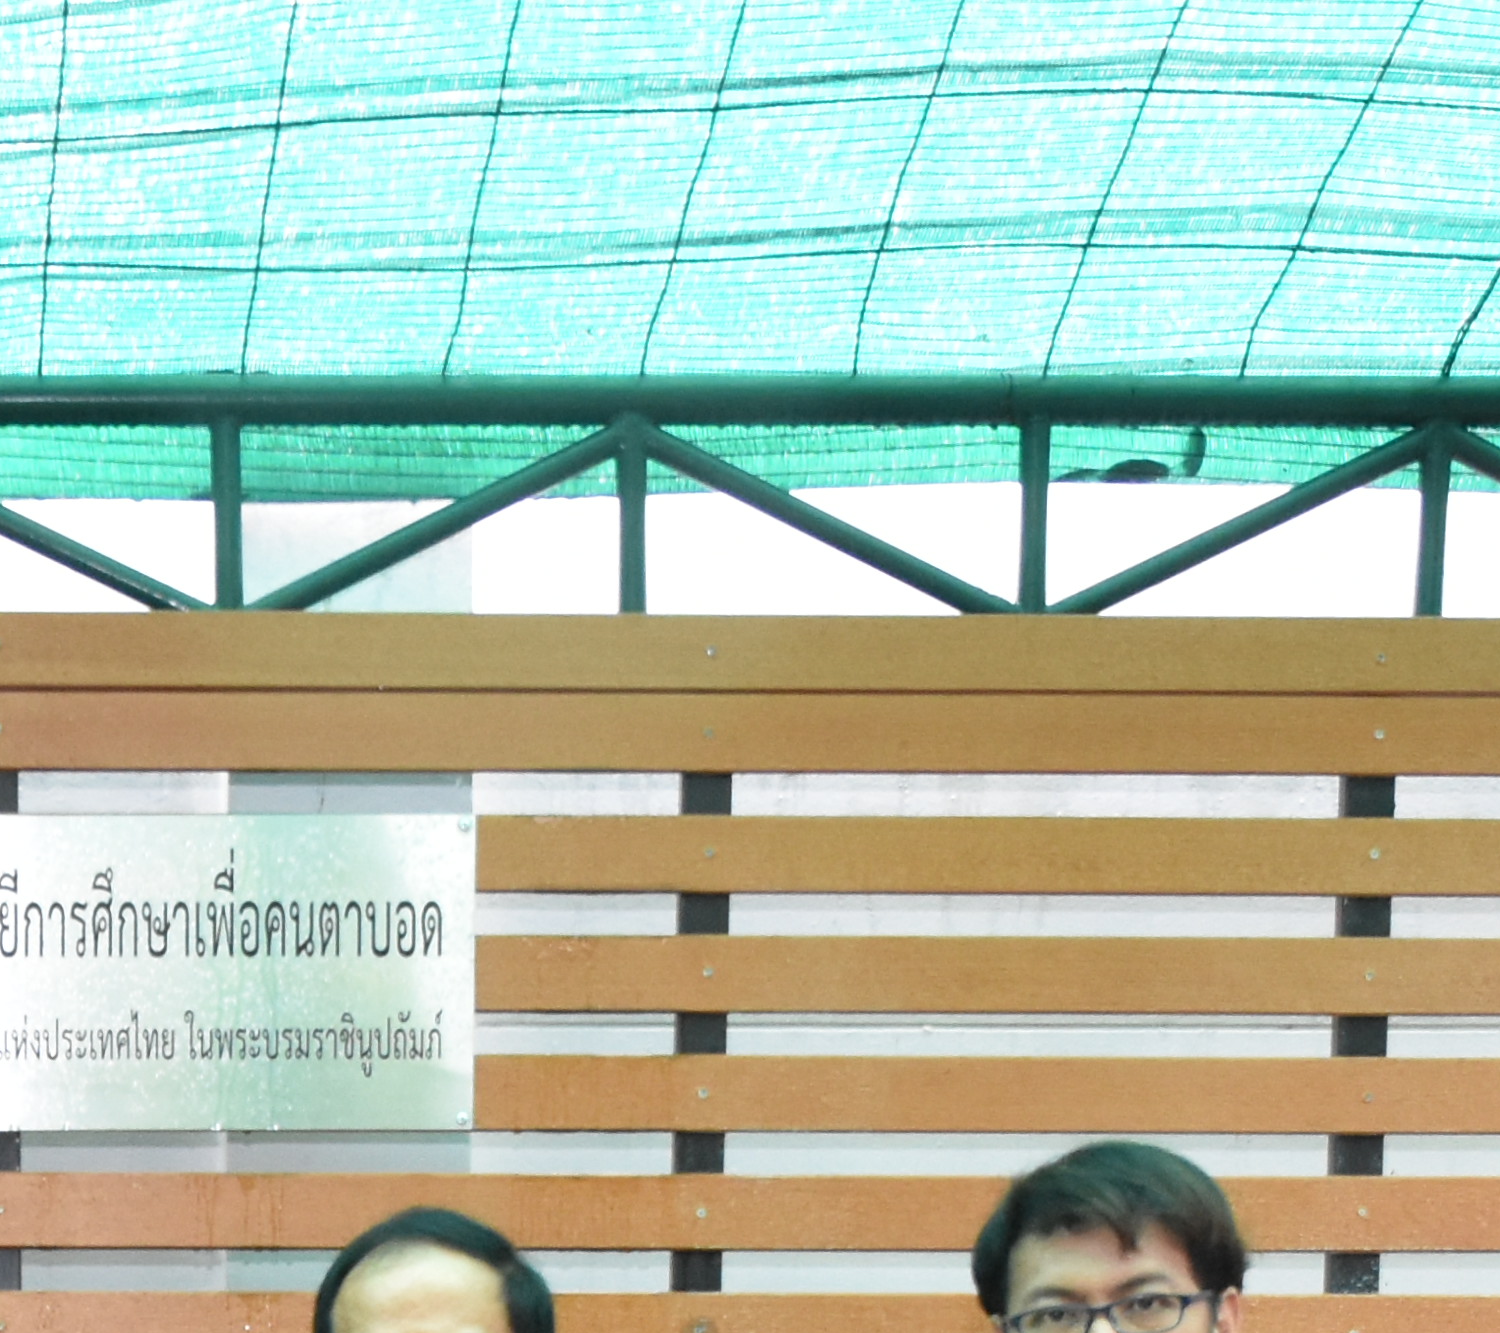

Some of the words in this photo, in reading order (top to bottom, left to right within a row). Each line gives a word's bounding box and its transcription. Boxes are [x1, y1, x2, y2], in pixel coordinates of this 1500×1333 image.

[184, 1009, 443, 1078] ในพระบรมราชินูปถัมภ์
